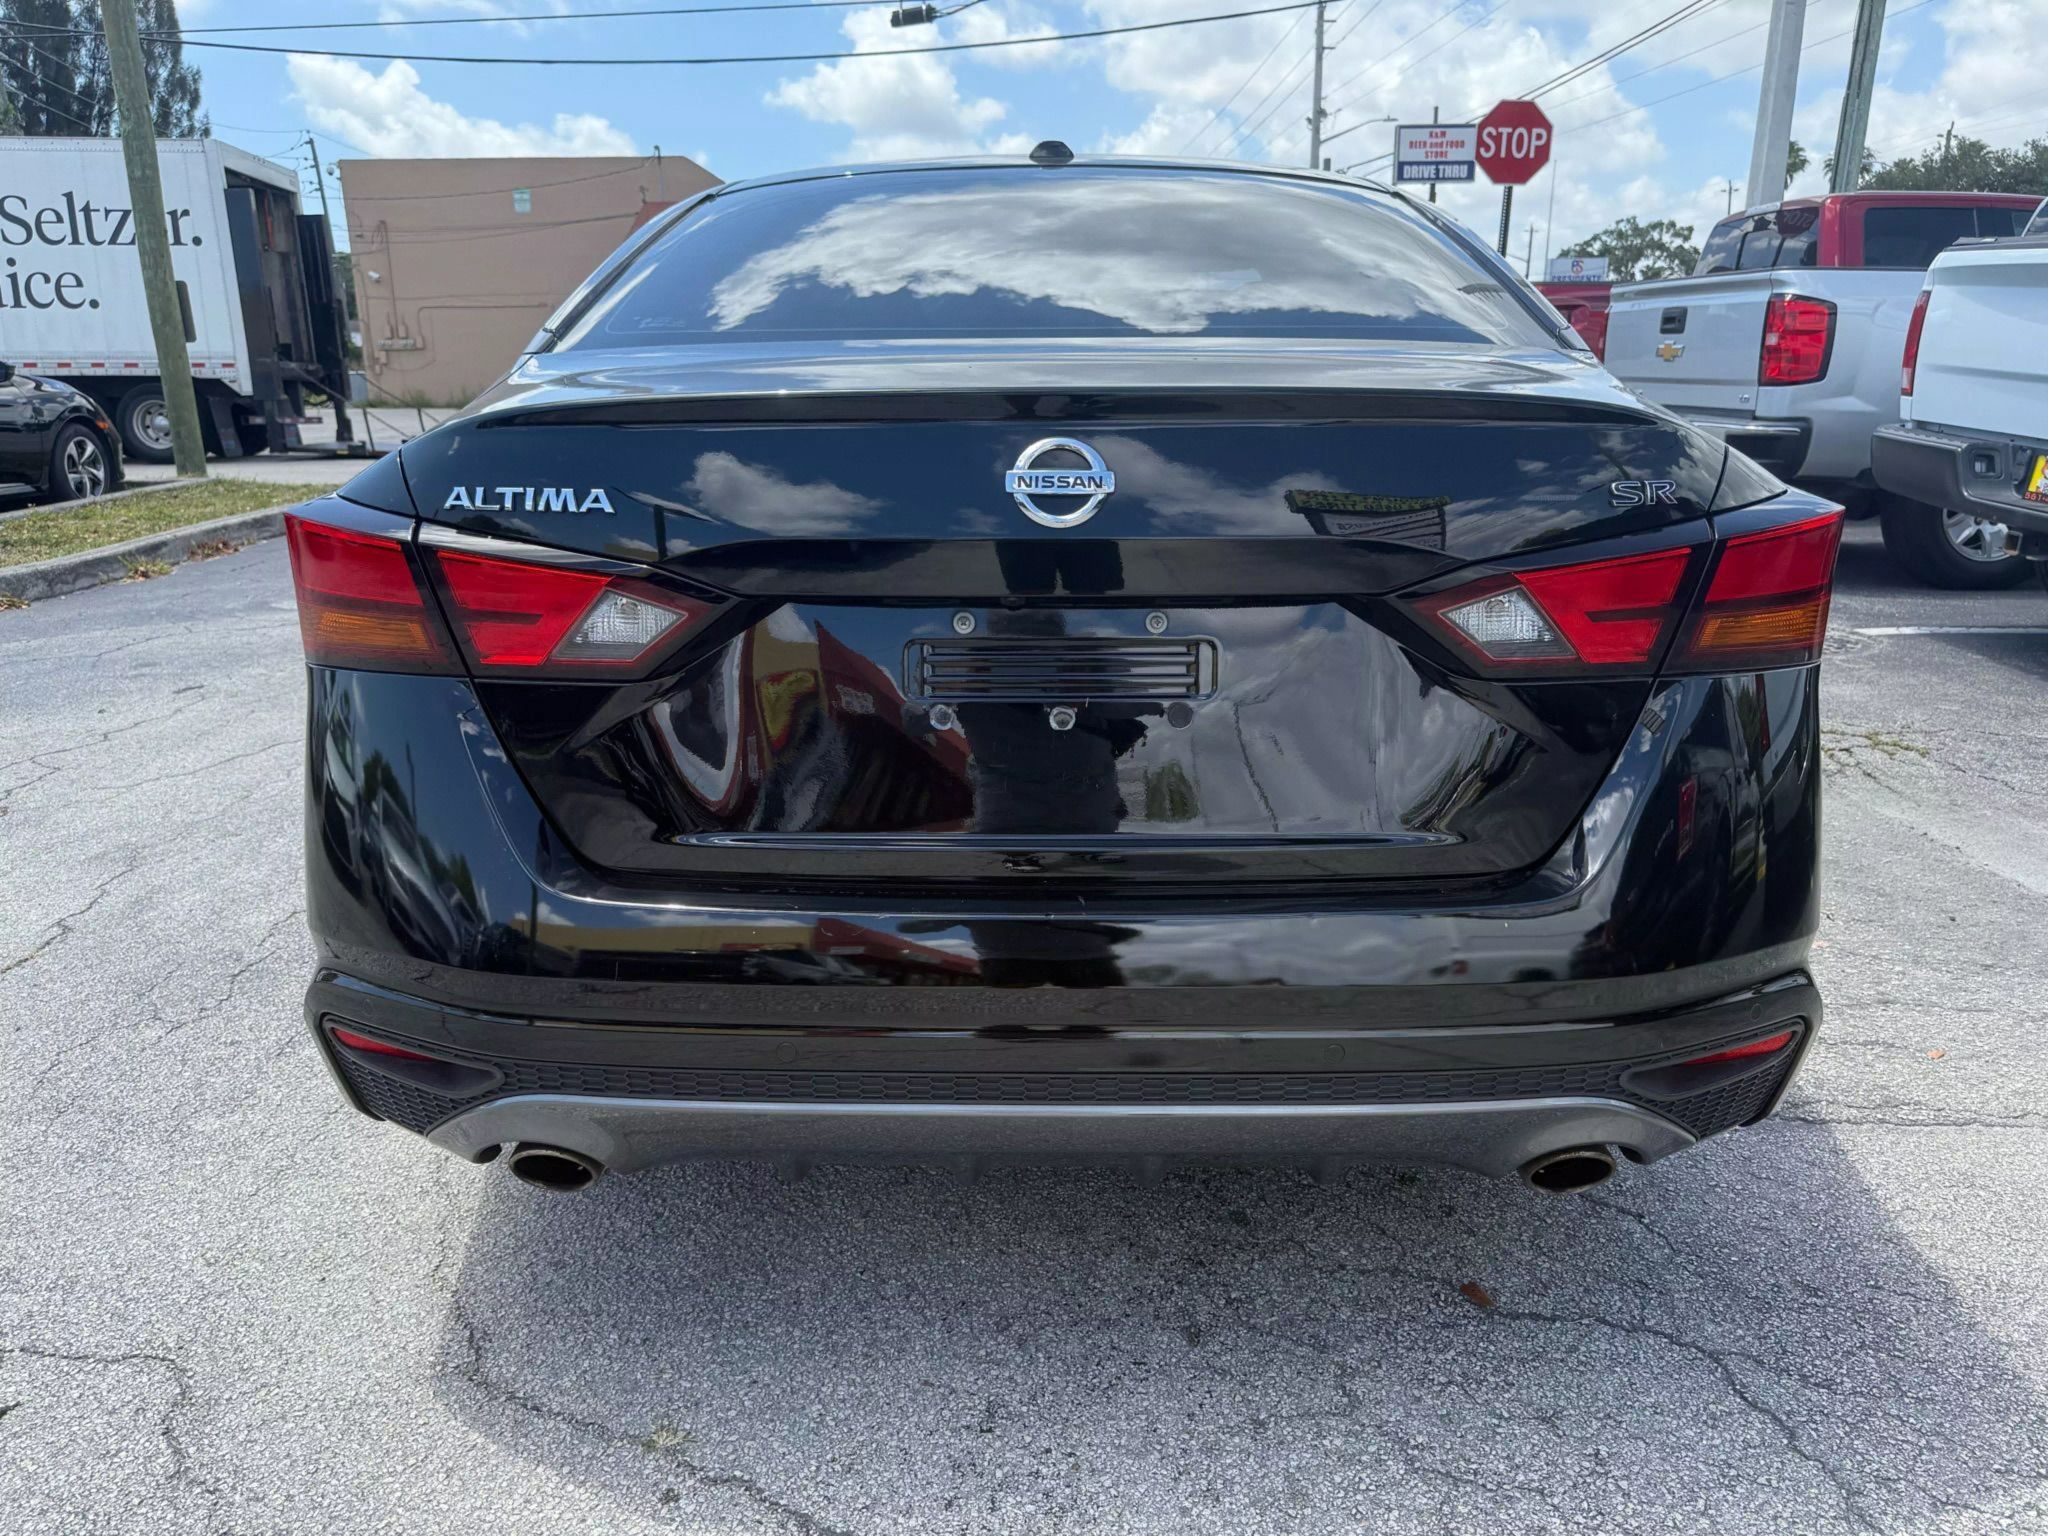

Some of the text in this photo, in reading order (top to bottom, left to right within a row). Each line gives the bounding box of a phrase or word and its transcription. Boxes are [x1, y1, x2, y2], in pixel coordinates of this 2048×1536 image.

[1408, 140, 1427, 149] BEER
[1446, 140, 1465, 149] FOOD
[1424, 150, 1448, 159] STORE
[1480, 126, 1547, 159] STOP
[1403, 165, 1468, 179] DRIVE THRU
[0, 190, 203, 247] Seltzr.
[0, 257, 100, 309] ice.
[1017, 475, 1103, 489] NISSAN
[1611, 480, 1678, 506] SR
[443, 486, 616, 513] ALTIMA
